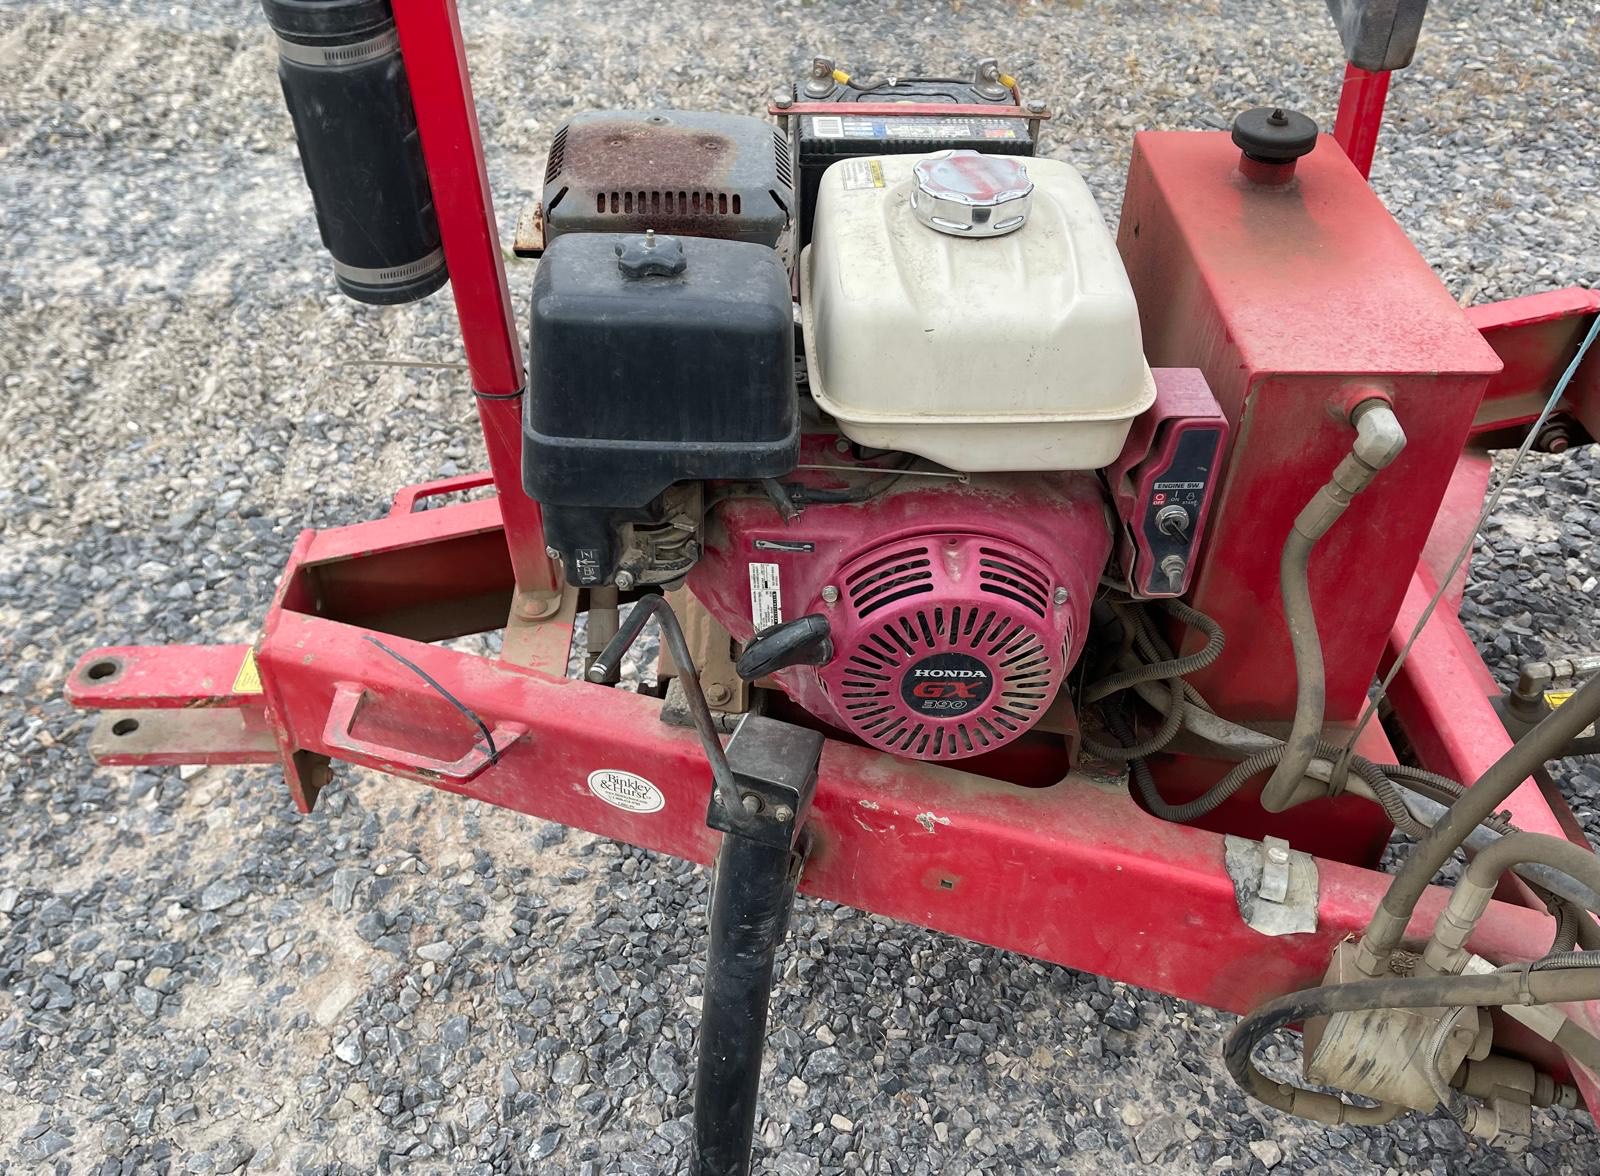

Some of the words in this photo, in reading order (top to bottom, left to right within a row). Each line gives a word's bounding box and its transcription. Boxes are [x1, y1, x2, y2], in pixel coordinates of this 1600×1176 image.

[913, 669, 987, 678] HONDA
[913, 681, 983, 699] GX
[921, 699, 968, 709] 390
[608, 774, 651, 793] Binkley
